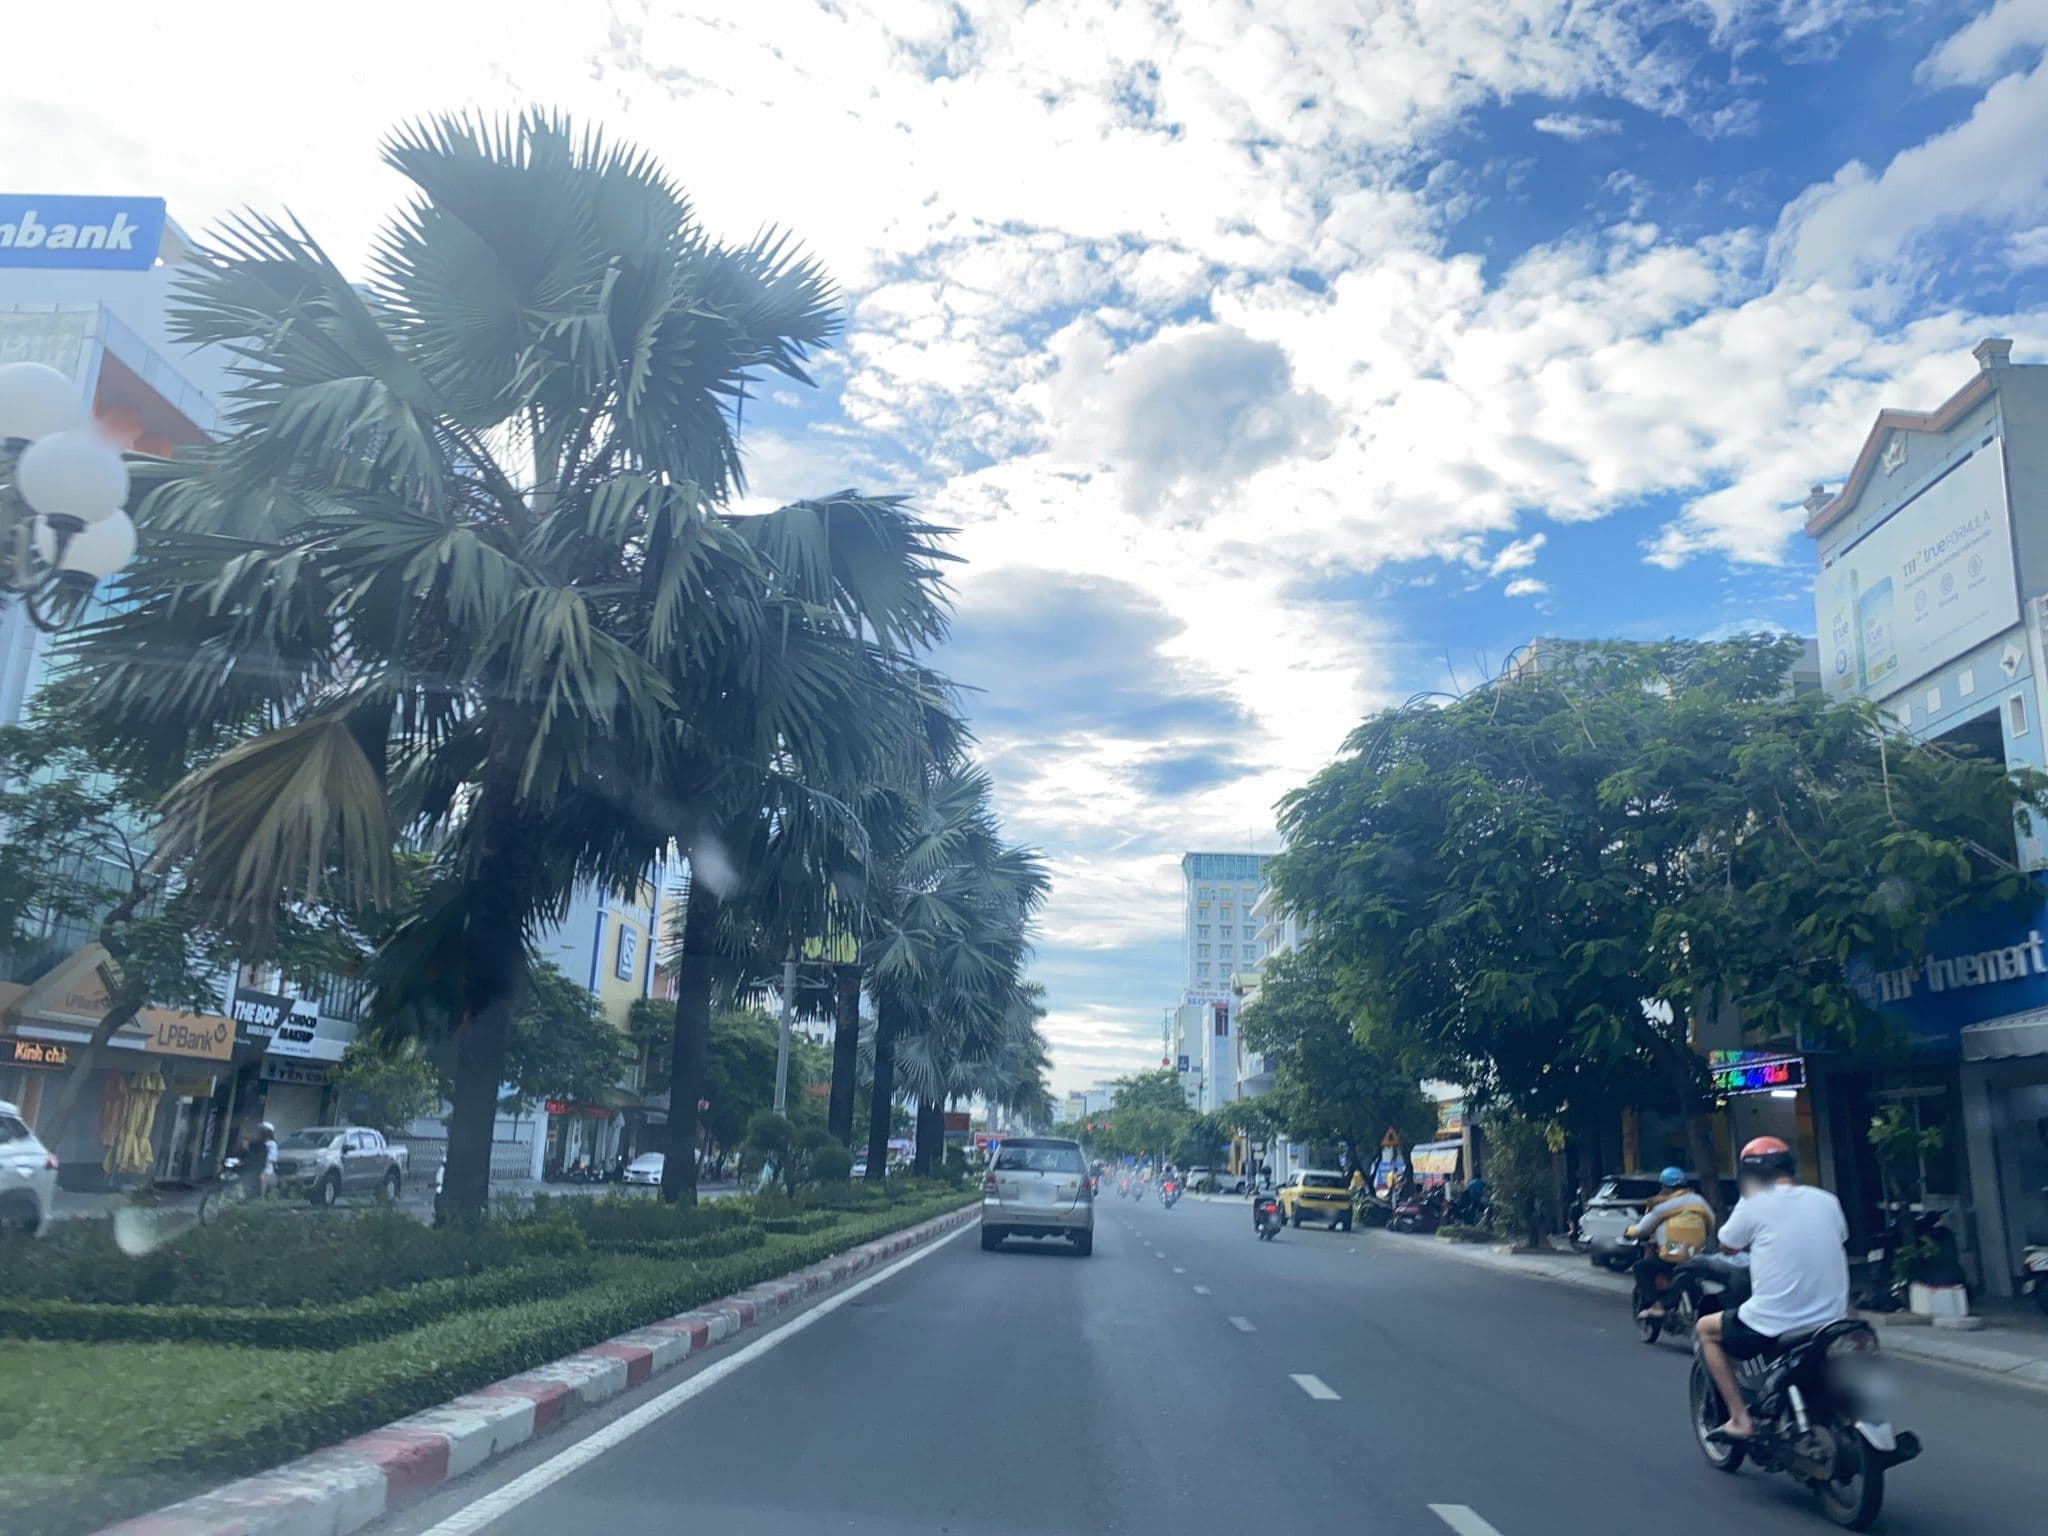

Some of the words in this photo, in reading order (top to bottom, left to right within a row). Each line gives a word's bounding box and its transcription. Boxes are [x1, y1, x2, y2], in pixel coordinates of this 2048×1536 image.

[234, 1000, 257, 1023] THE
[287, 1012, 318, 1029] CHOCO
[158, 1021, 213, 1053] LPBank
